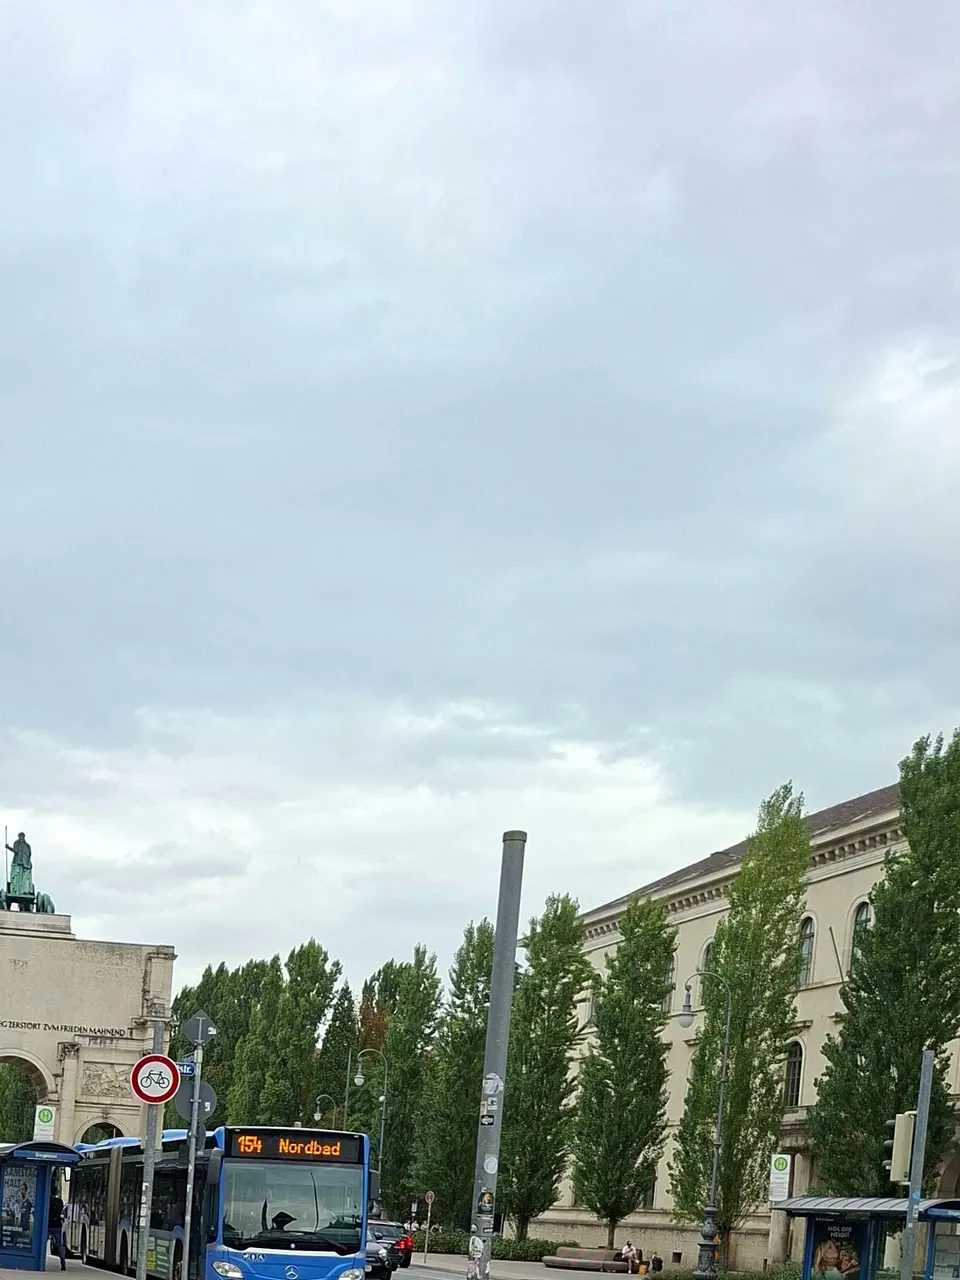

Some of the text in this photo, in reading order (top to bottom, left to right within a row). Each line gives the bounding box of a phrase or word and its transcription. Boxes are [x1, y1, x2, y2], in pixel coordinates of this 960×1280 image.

[60, 1025, 88, 1034] FRIEDEN
[89, 1027, 126, 1037] MAHNEND
[238, 1136, 341, 1156] 154 Nordbad
